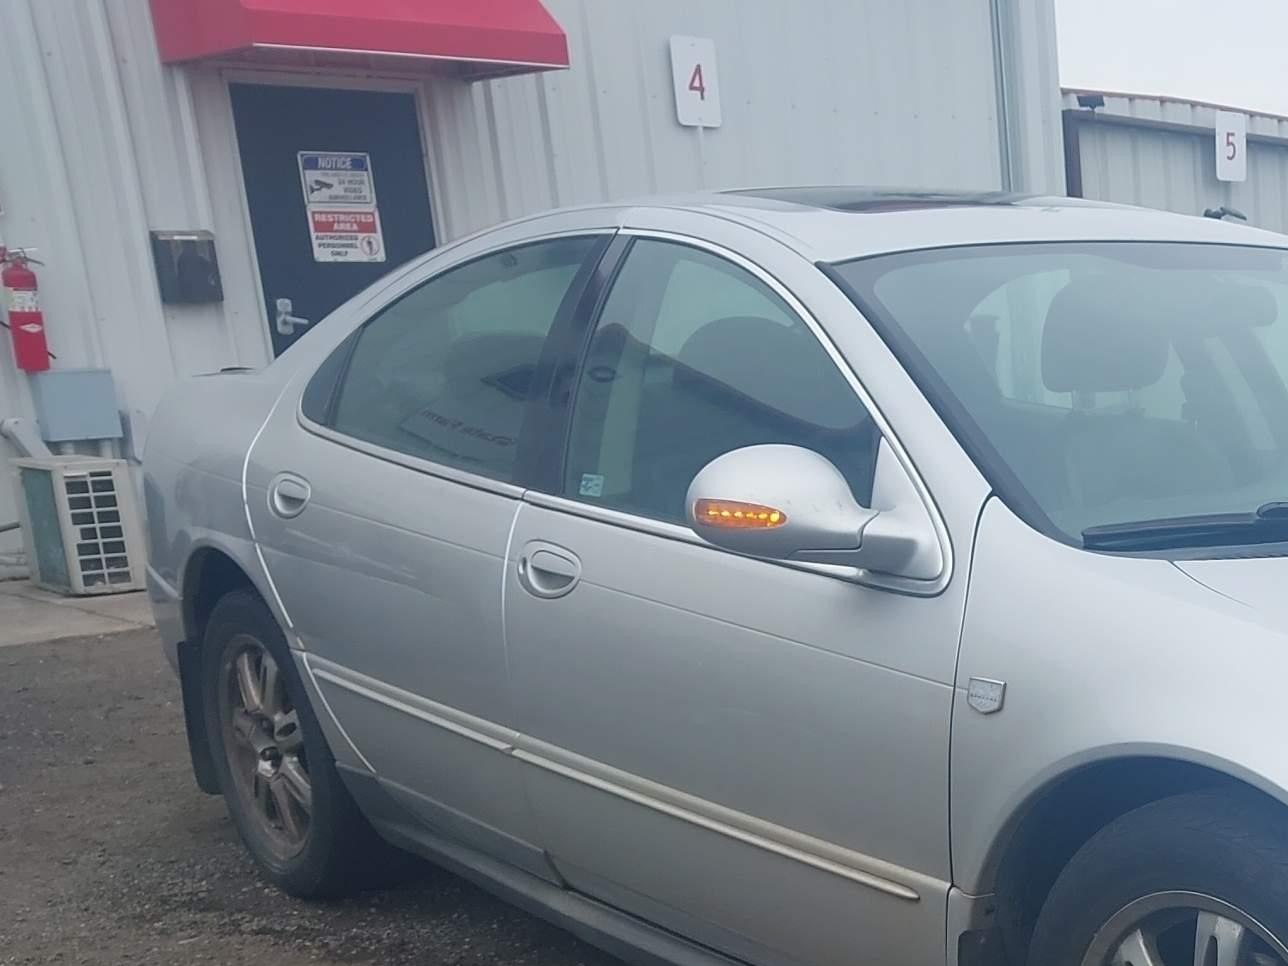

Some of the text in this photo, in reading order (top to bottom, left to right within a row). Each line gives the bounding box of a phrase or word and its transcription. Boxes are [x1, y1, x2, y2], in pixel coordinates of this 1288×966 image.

[688, 63, 706, 101] 4
[1225, 132, 1237, 161] 5
[318, 157, 352, 169] NOTICE
[314, 213, 374, 222] RESTRICTED
[333, 222, 358, 231] AREA
